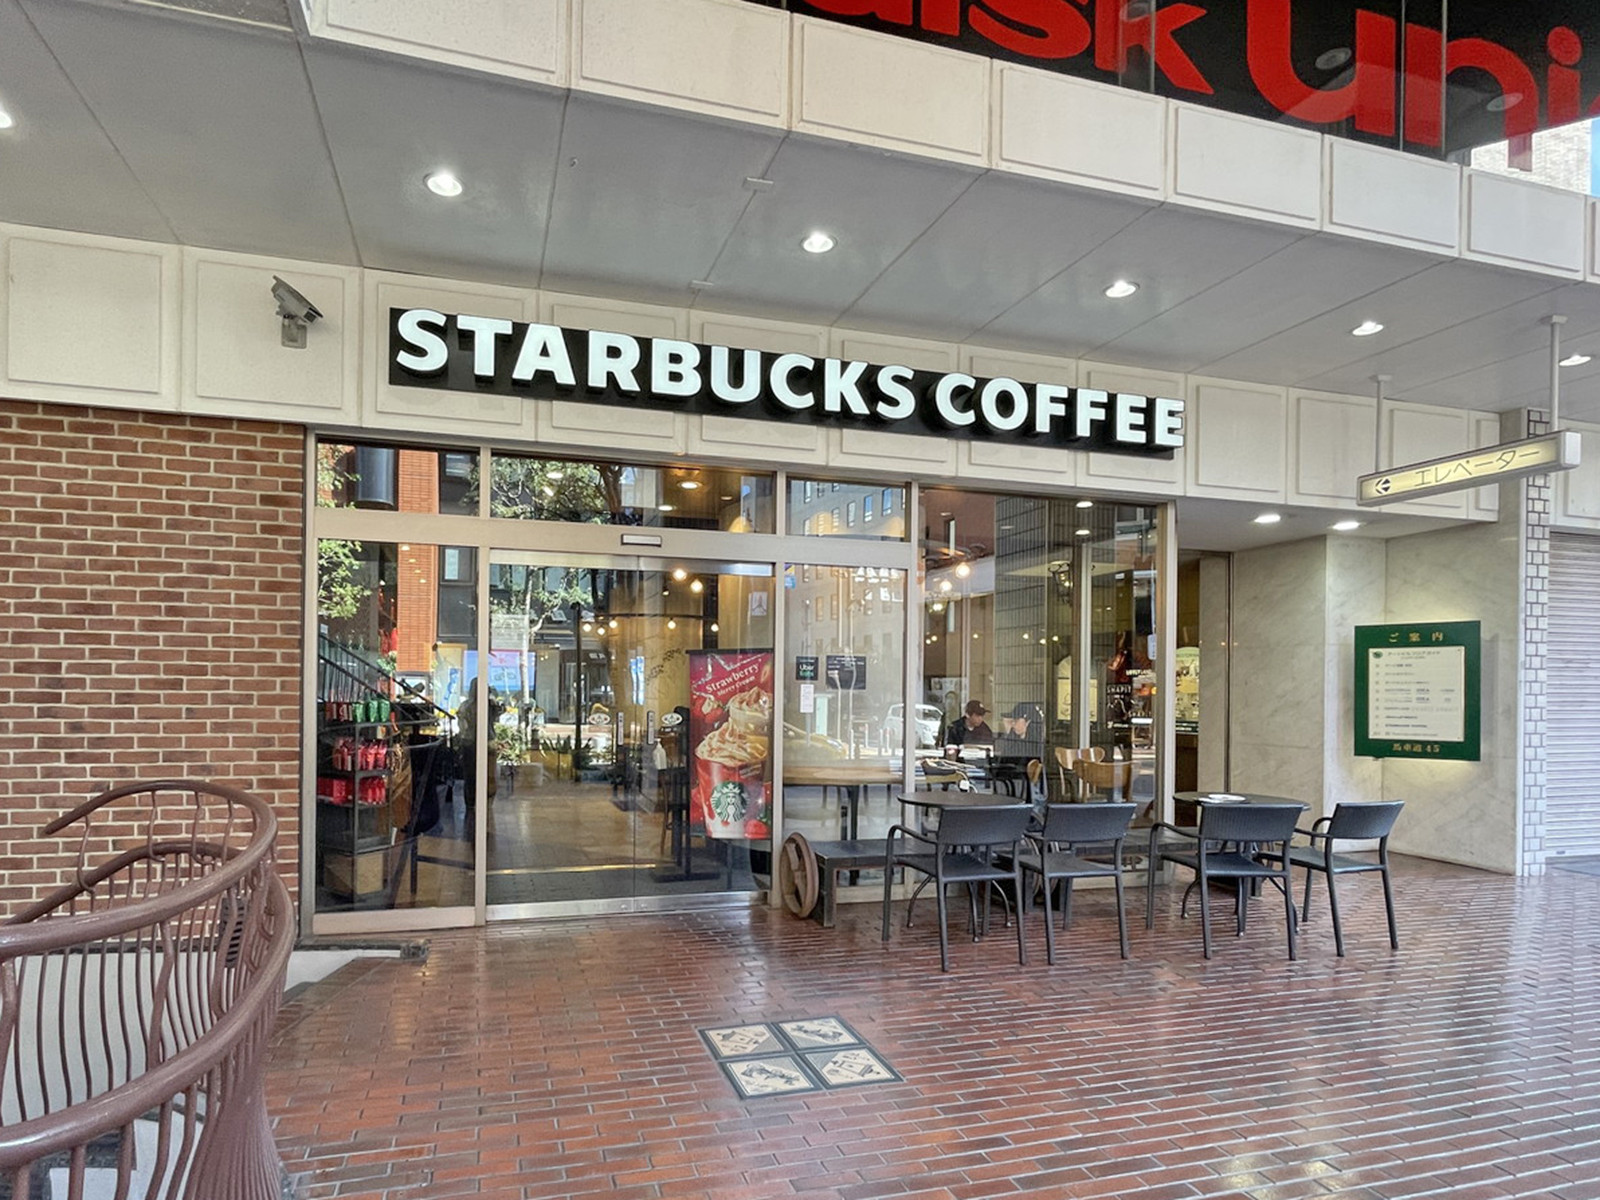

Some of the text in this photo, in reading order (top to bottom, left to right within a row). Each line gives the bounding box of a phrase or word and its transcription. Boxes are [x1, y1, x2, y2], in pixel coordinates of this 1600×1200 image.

[396, 308, 1185, 447] STARBUCKS COFFEE
[705, 663, 759, 693] Strawberry
[799, 663, 815, 671] Uber
